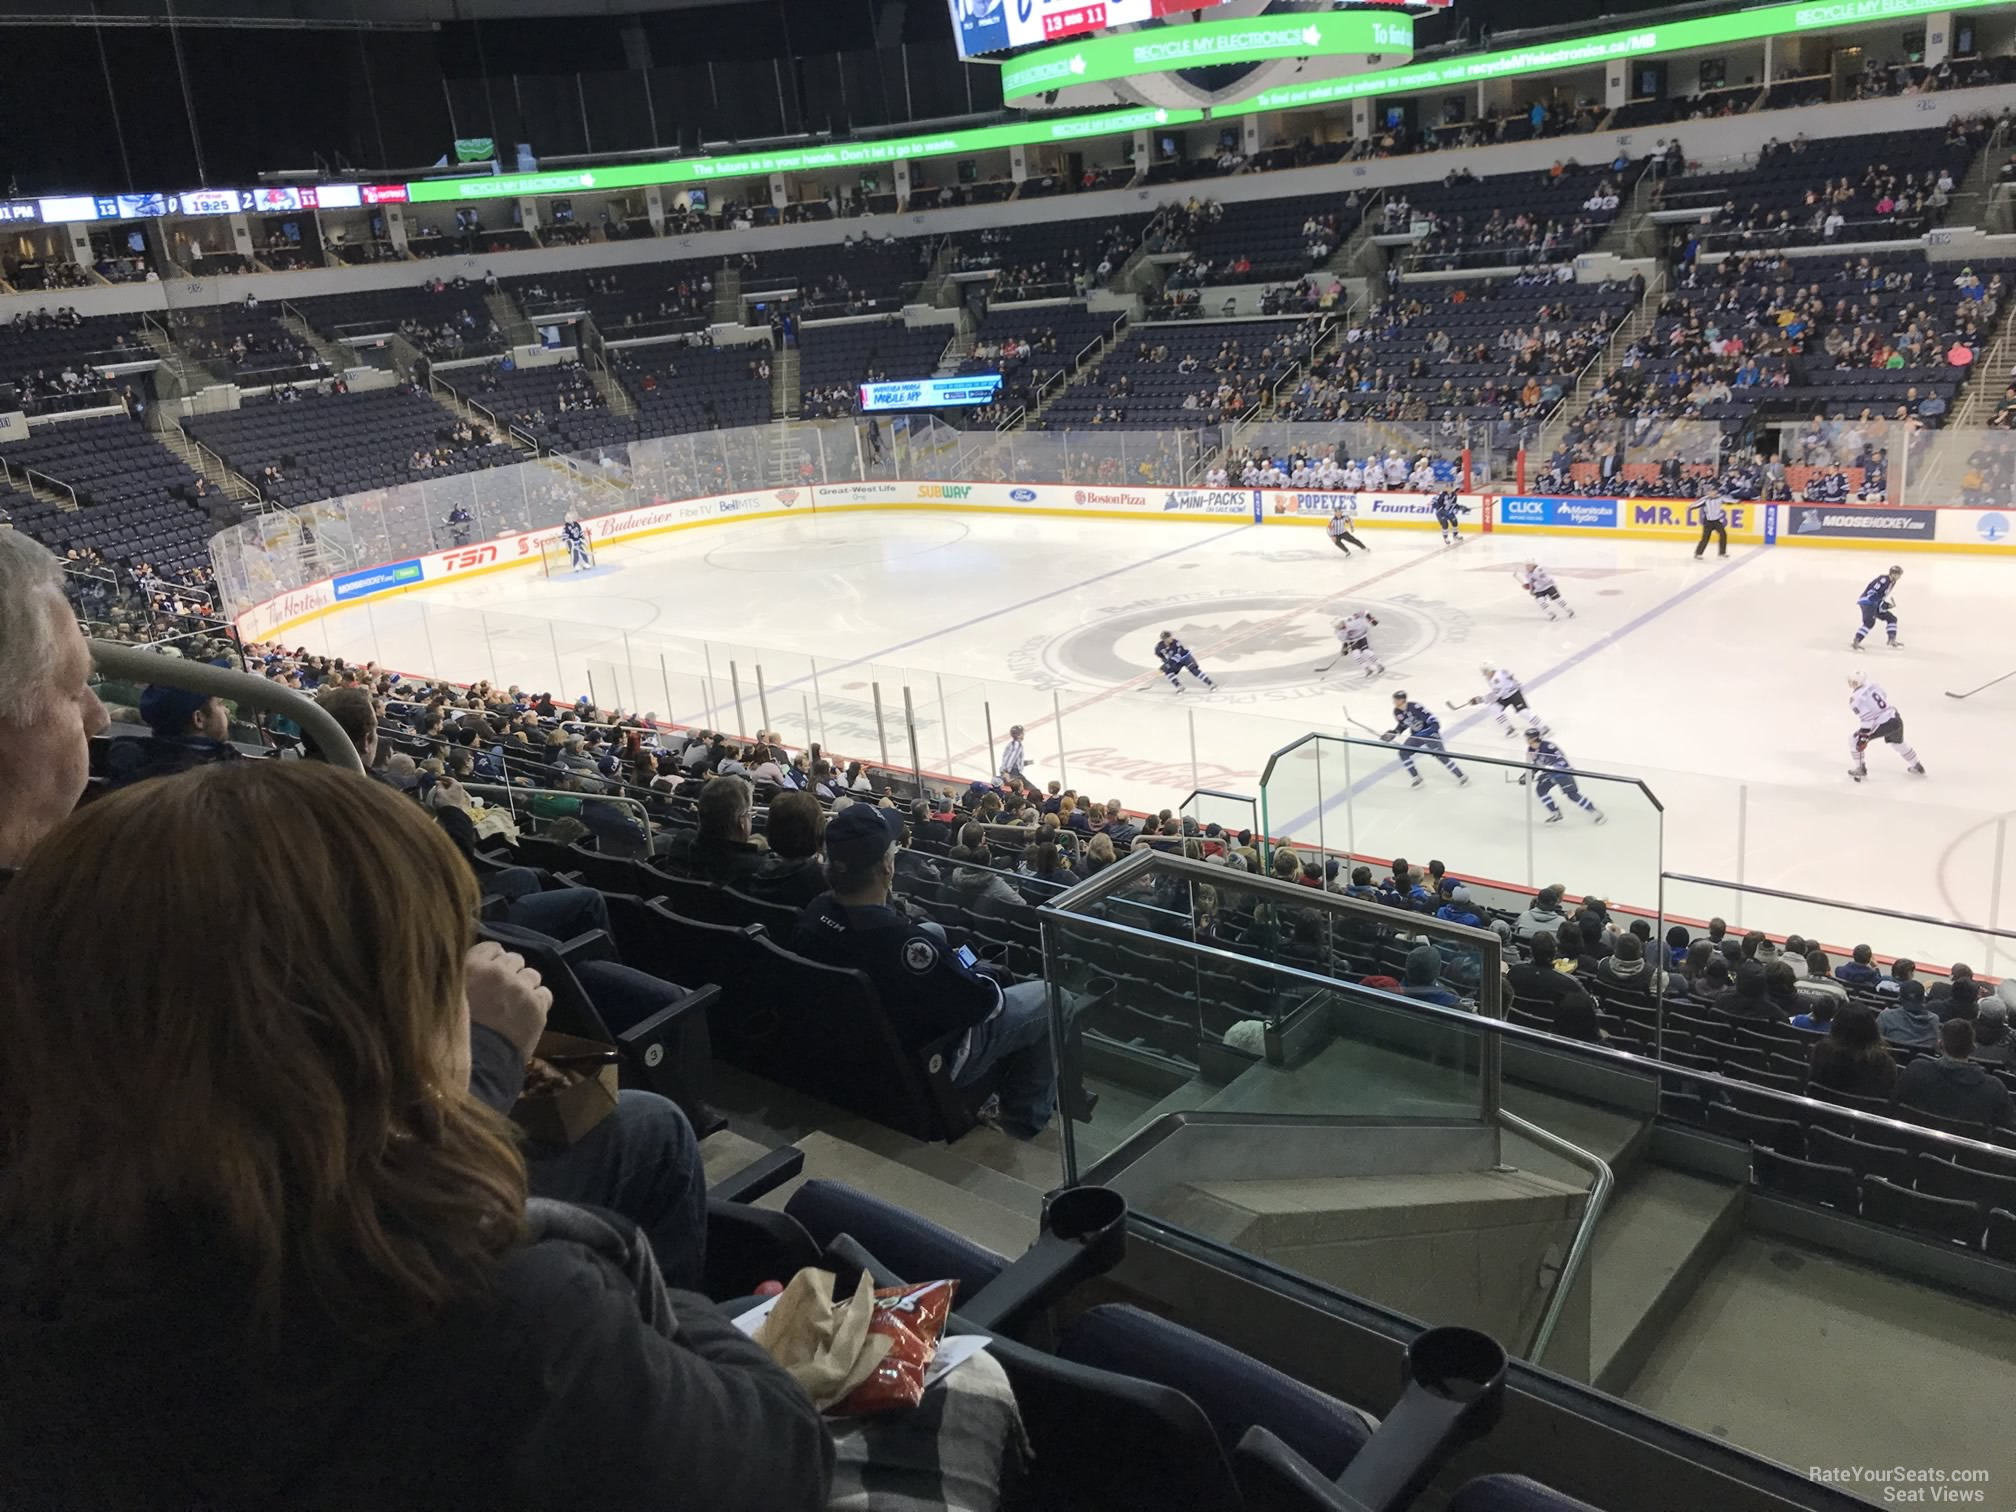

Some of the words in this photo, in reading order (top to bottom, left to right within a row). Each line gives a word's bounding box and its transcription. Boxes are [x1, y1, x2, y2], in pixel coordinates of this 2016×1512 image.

[1046, 16, 1063, 32] 13
[1086, 7, 1104, 24] 11
[1372, 24, 1388, 44] To
[1134, 39, 1190, 59] RECYCLE
[1193, 37, 1214, 50] MY
[1217, 29, 1300, 48] ELECTRONICS
[692, 164, 714, 176] The
[716, 161, 749, 174] future
[750, 159, 761, 171] is
[763, 158, 773, 169] in
[775, 156, 800, 170] your
[803, 151, 839, 166] hands.
[841, 149, 869, 162] Don't
[871, 147, 885, 159] let
[897, 145, 910, 159] go
[912, 143, 923, 155] to
[168, 196, 178, 213] 0
[193, 200, 229, 211] 19:25
[242, 192, 253, 209] 2
[302, 195, 317, 206] 11
[13, 205, 34, 218] PM
[99, 205, 117, 216] 13
[874, 392, 904, 404] MOBILE
[906, 391, 921, 402] APP
[819, 486, 876, 496] Great-West
[879, 484, 896, 492] Life
[917, 485, 972, 499] SUBWAY
[1013, 489, 1032, 501] Ford
[1180, 492, 1245, 510] MINI-PACKS
[1297, 493, 1357, 510] POPEYE'S
[1508, 501, 1544, 514] CLICK
[680, 507, 698, 518] Fibe
[699, 504, 712, 515] TV
[1571, 505, 1613, 516] Manitoba
[1635, 505, 1680, 525] MR.
[602, 511, 673, 537] Budweiser
[1571, 514, 1599, 524] Hydro
[1822, 514, 1925, 530] MOOSEHOCKEY.com
[442, 545, 497, 571] TSN
[1872, 691, 1887, 710] 8
[820, 914, 846, 932] CCM
